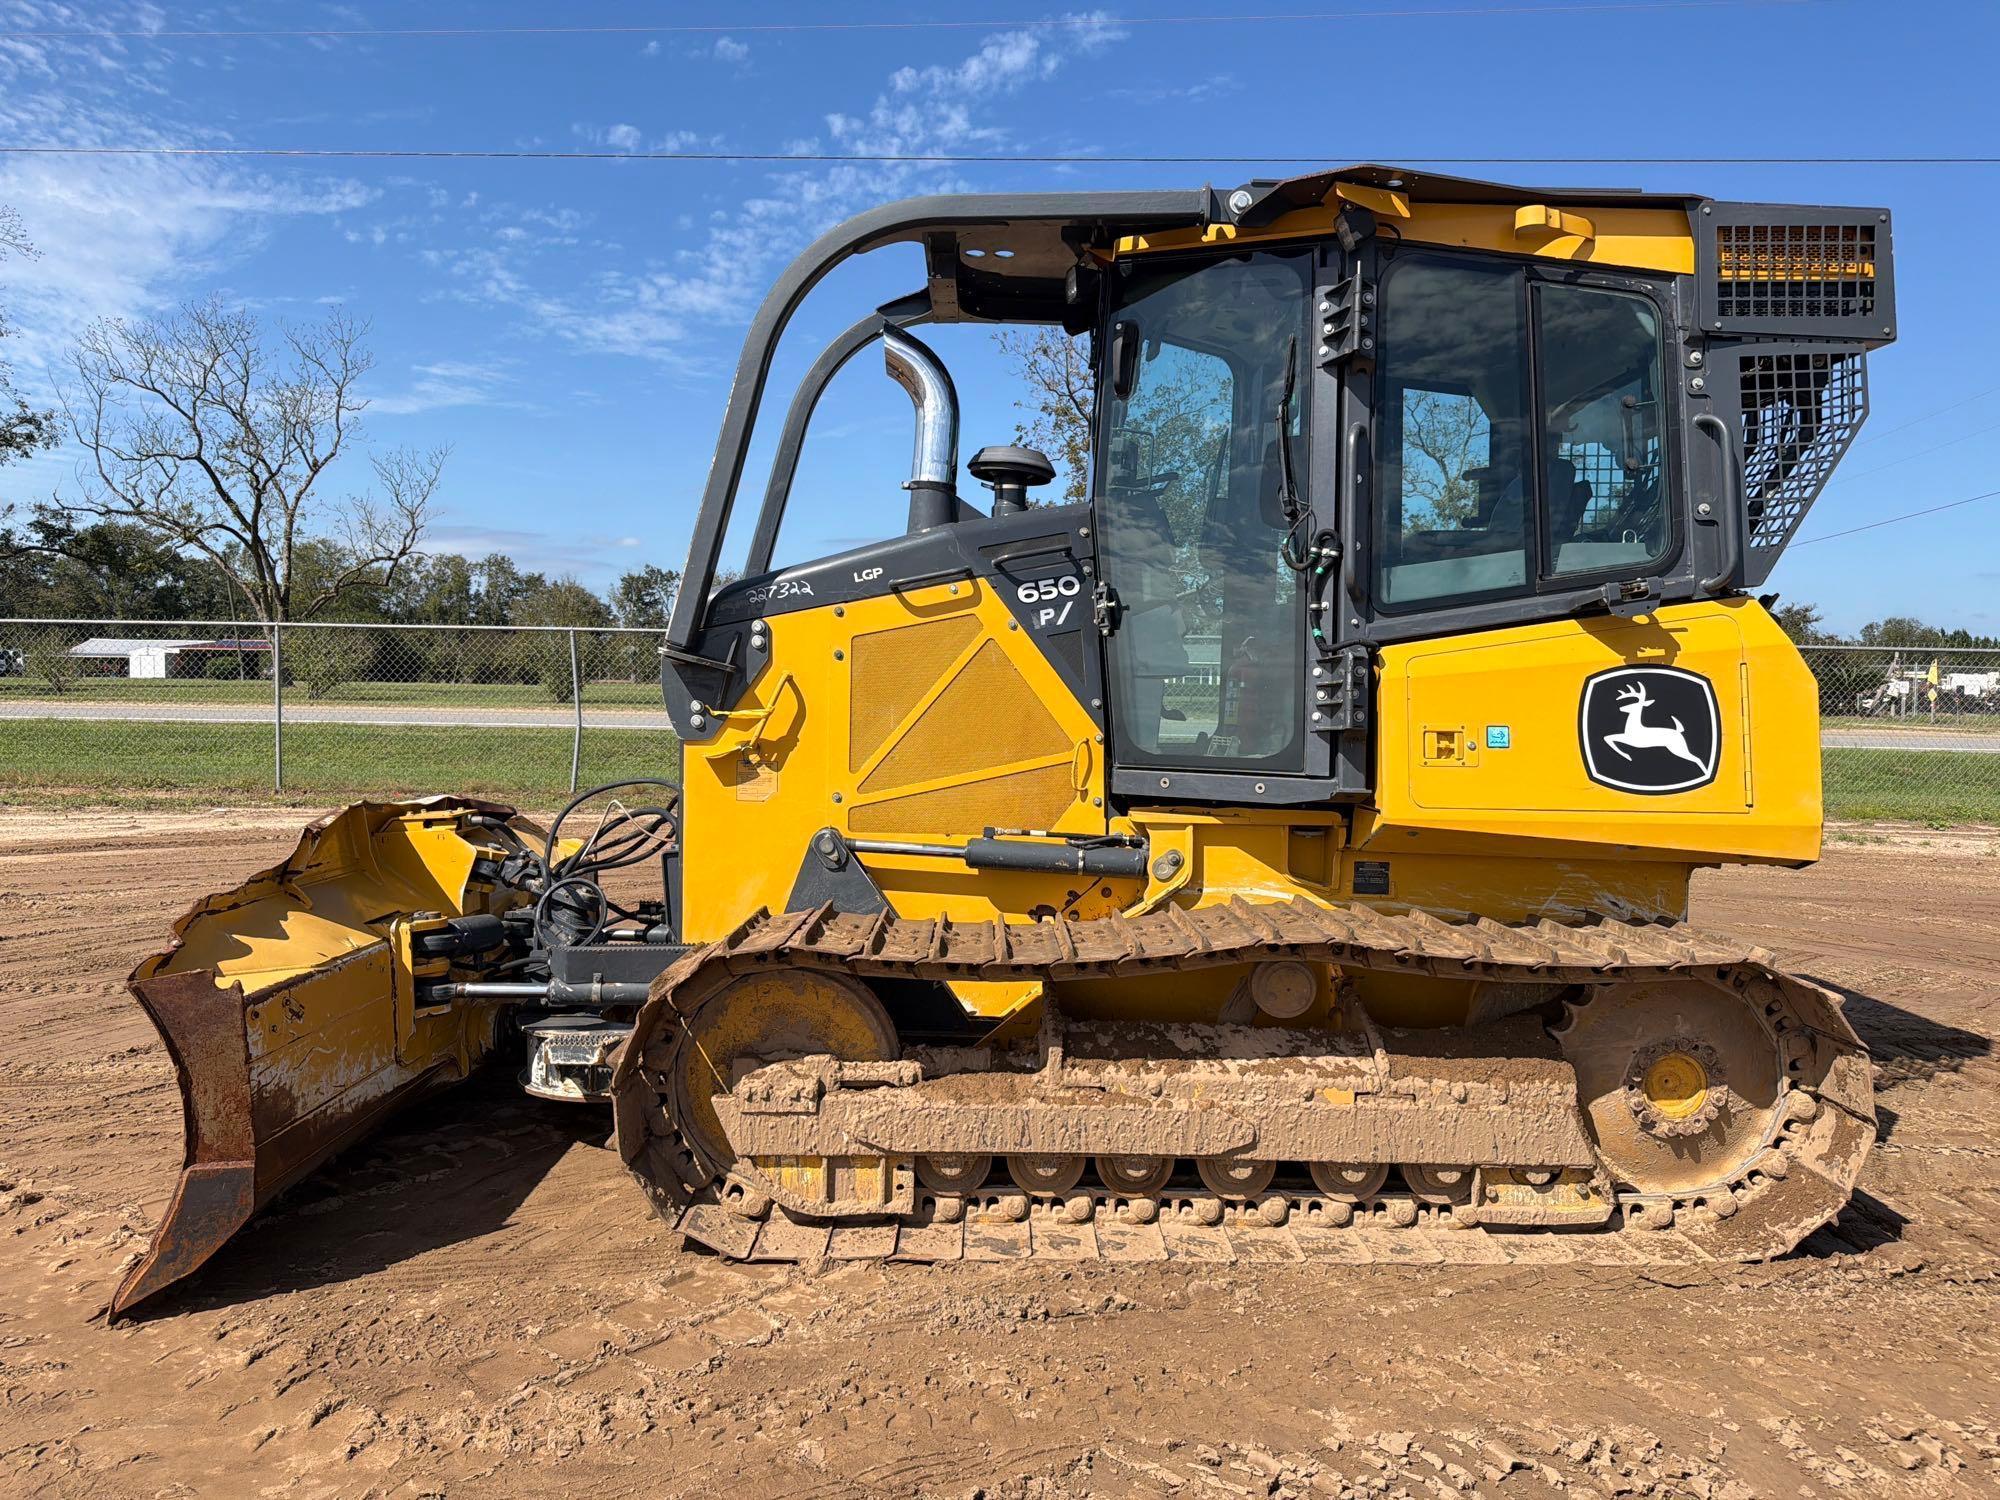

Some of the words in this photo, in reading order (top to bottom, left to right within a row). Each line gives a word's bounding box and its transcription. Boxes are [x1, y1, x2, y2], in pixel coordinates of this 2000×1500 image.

[853, 567, 884, 583] LGP
[745, 580, 815, 603] 227322
[1017, 575, 1081, 604] 650
